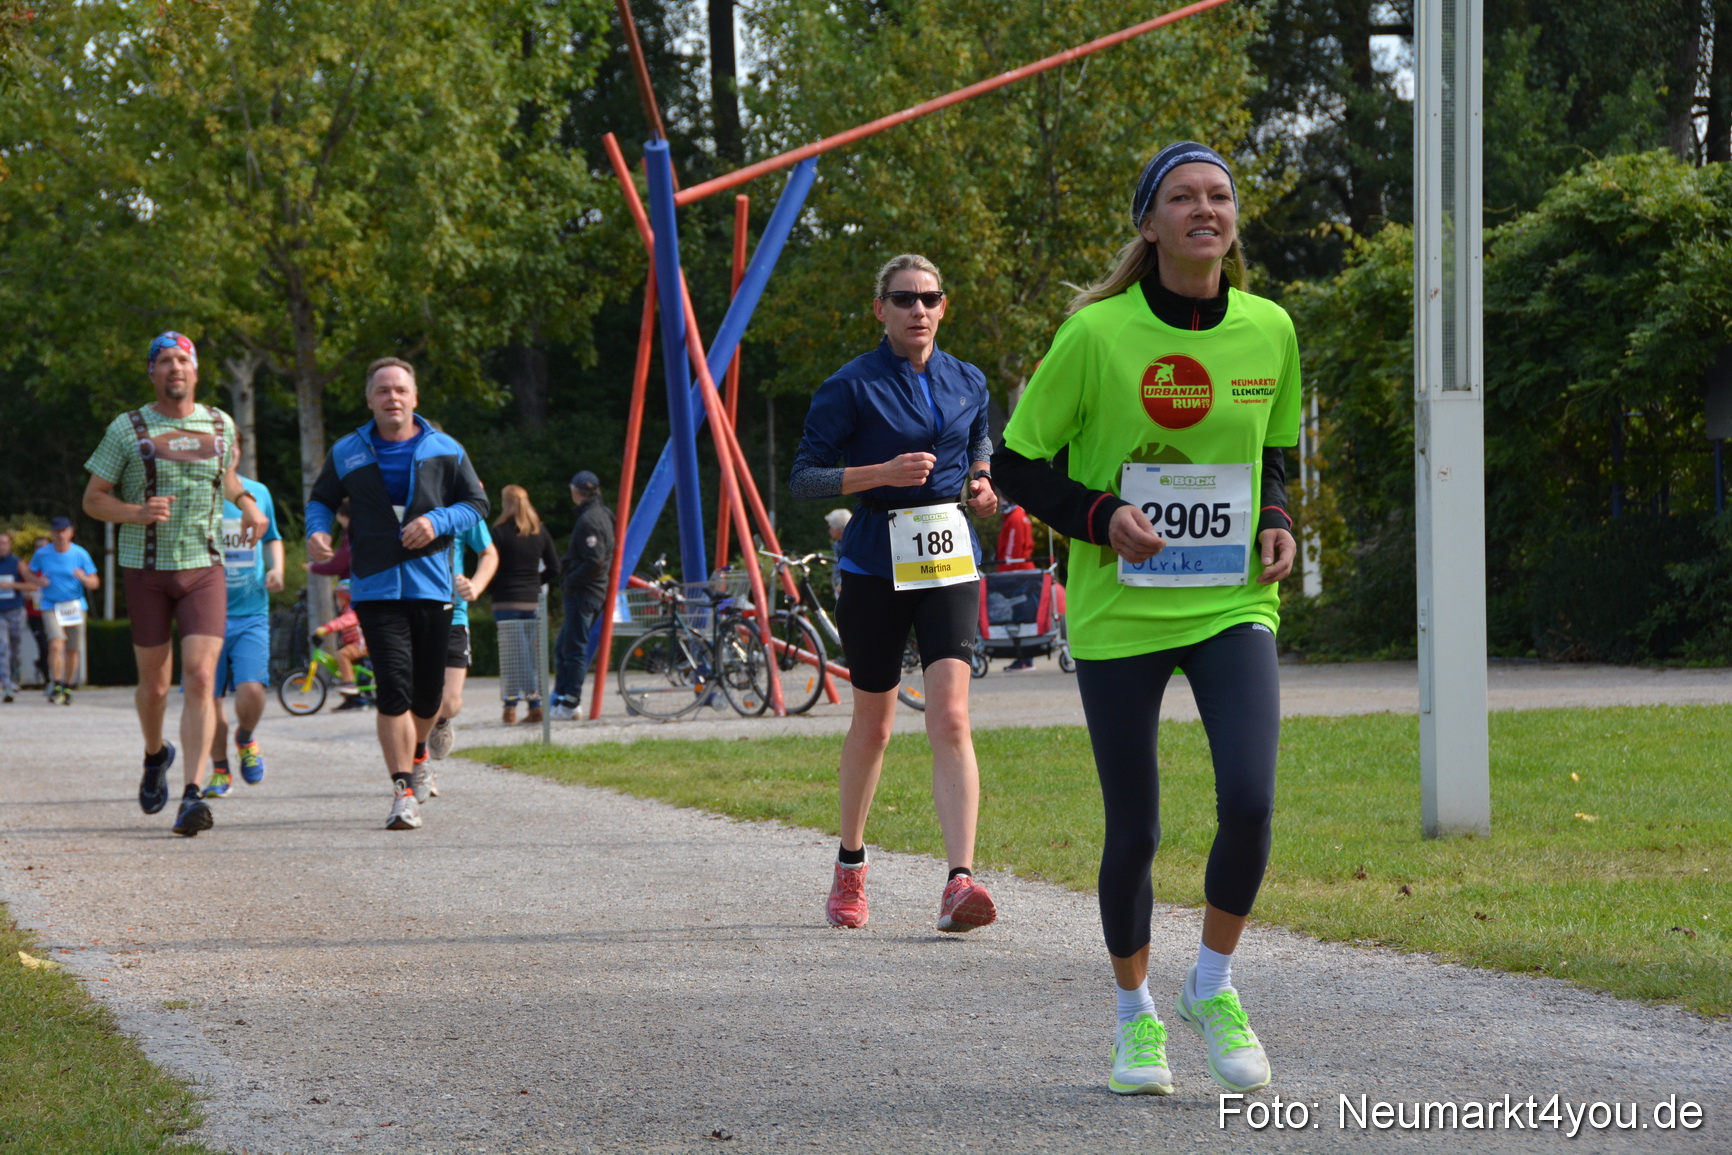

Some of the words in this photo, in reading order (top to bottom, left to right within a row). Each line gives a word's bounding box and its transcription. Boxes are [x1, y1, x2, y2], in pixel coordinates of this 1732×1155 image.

[1145, 387, 1208, 396] URBANIAN
[1173, 475, 1216, 486] BOCK
[922, 512, 948, 521] BOCK
[1141, 502, 1231, 539] 2905
[912, 530, 954, 556] 188
[920, 563, 951, 574] Martina
